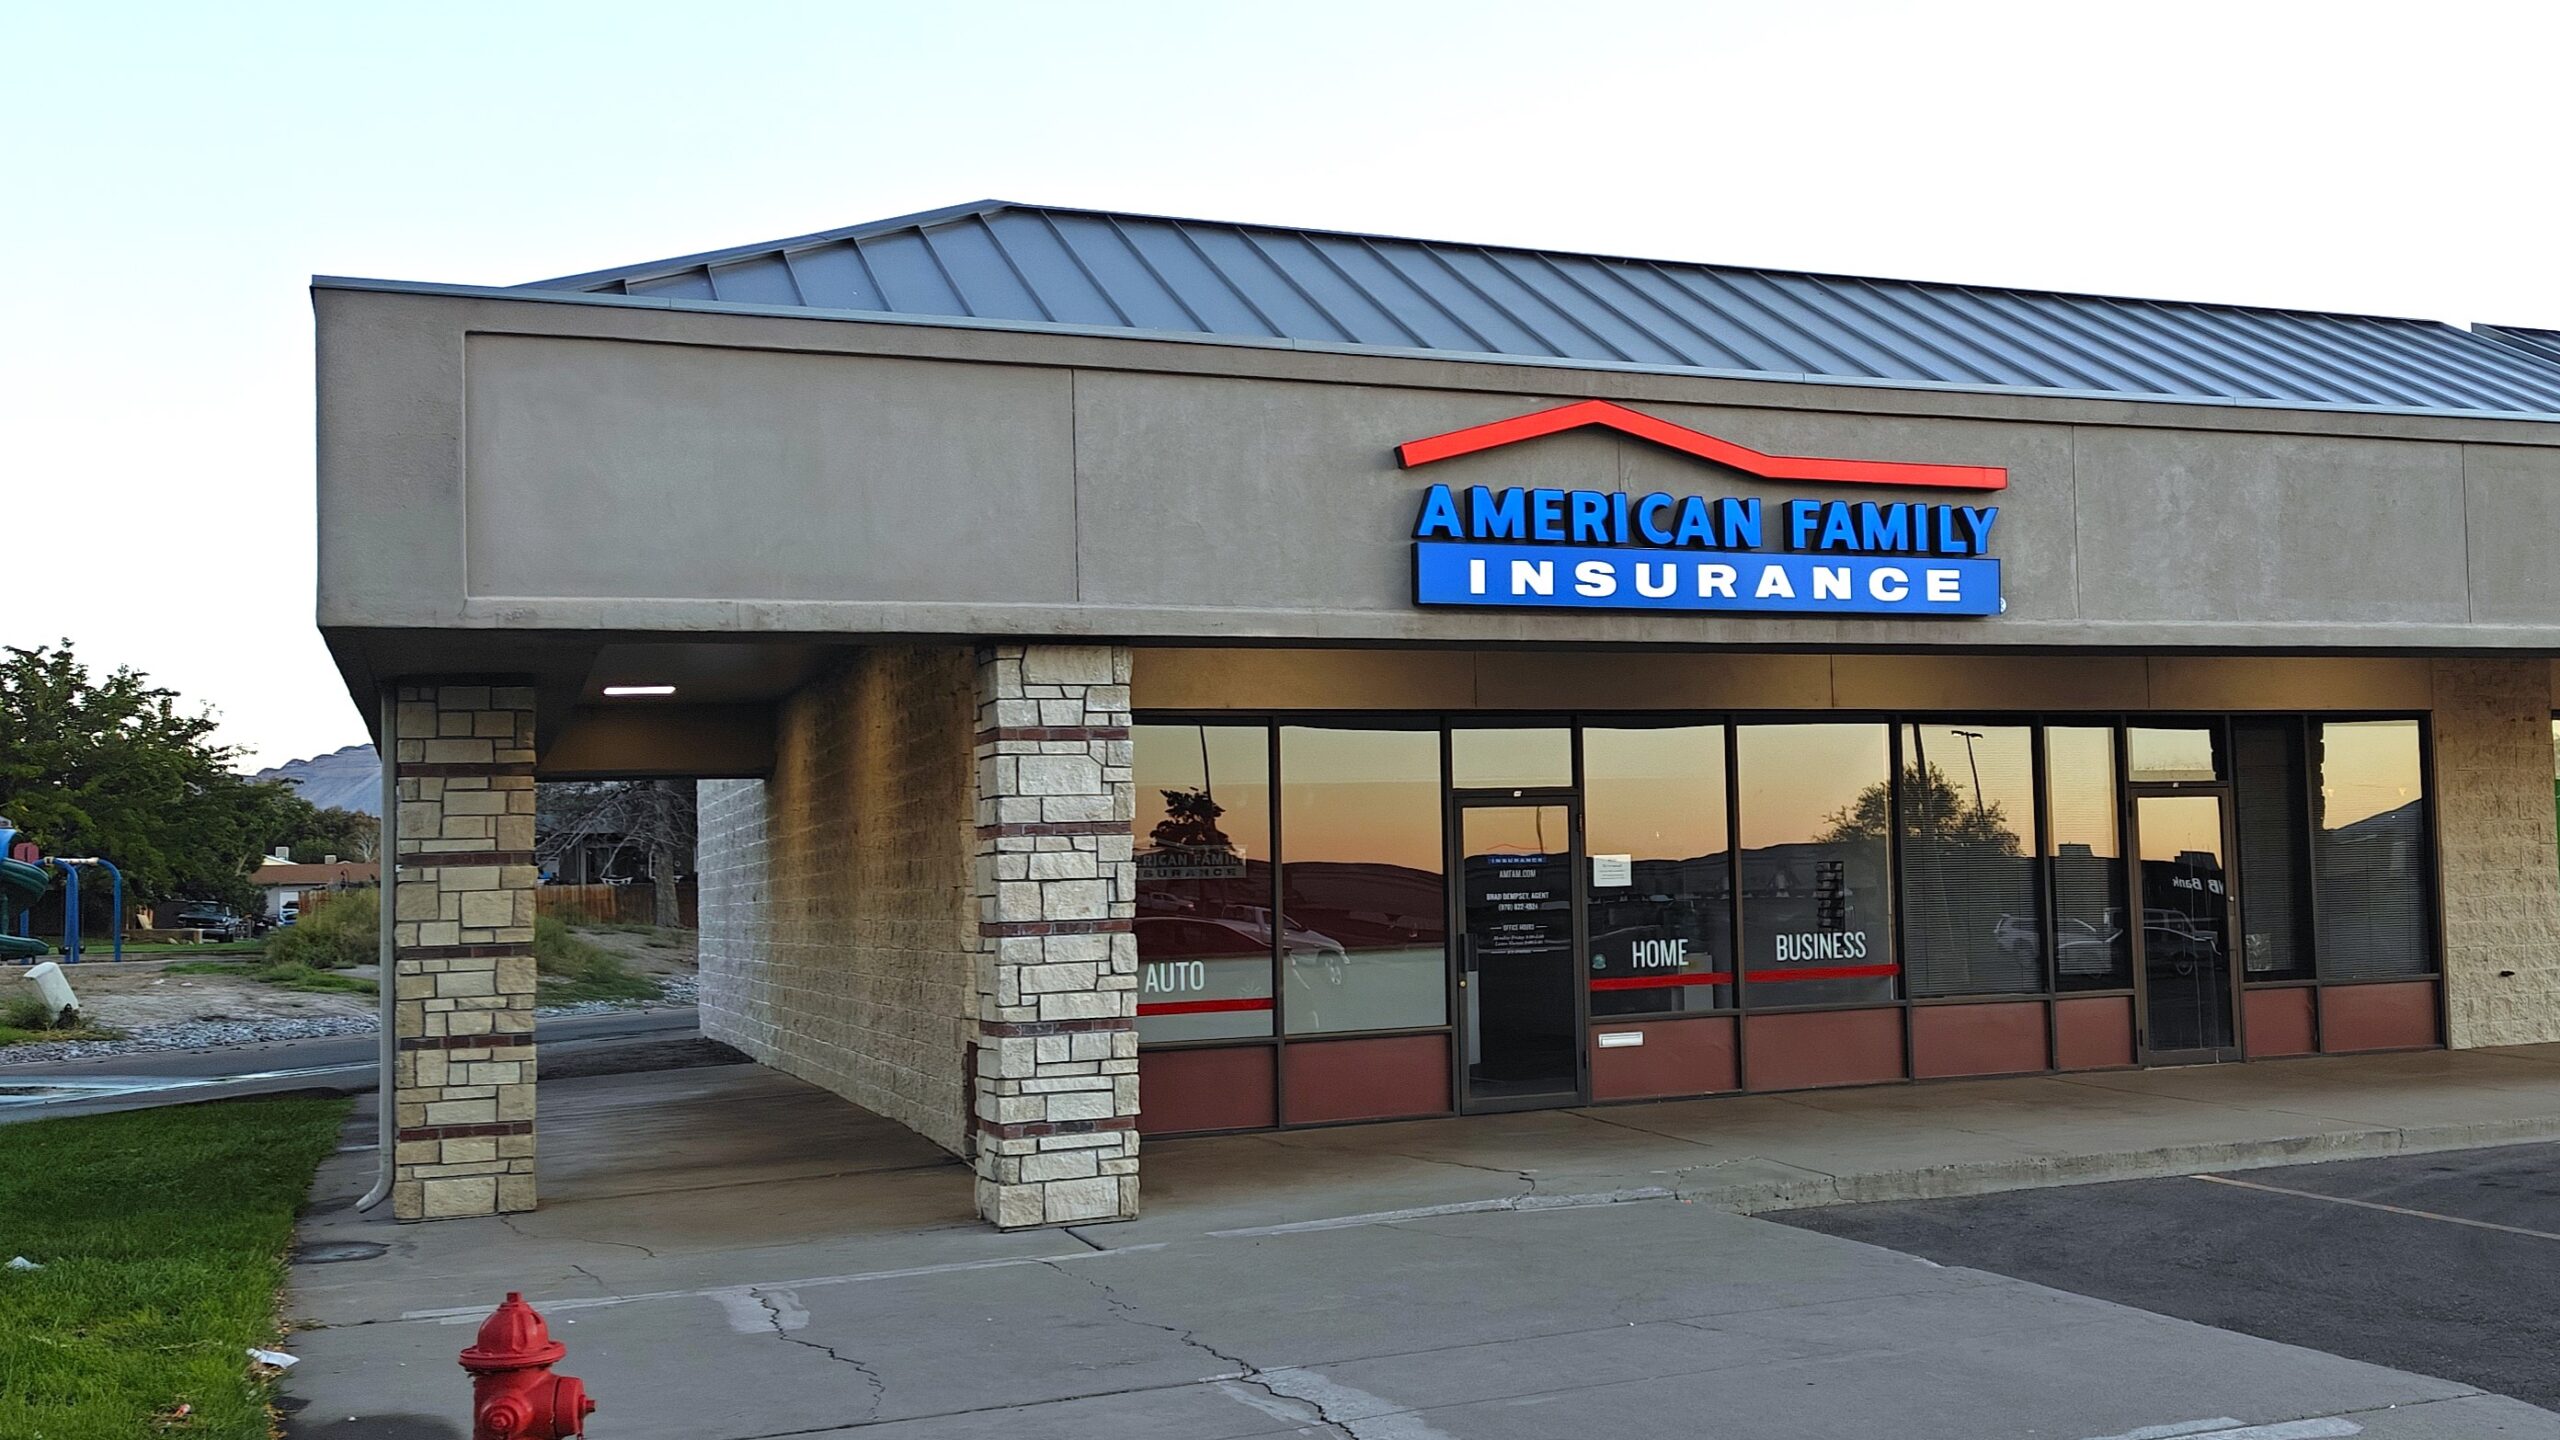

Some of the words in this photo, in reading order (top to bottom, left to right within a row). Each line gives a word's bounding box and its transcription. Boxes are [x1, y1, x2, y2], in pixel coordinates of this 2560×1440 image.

[1412, 484, 1763, 549] AMERICAN
[1783, 499, 1999, 556] FAMILY
[1470, 559, 1962, 602] INSURANCE
[1142, 867, 1237, 878] SURANCE
[1531, 891, 1549, 899] AGENT
[1632, 938, 1689, 969] HOME
[1776, 931, 1867, 962] BUSINESS
[1144, 960, 1206, 993] AUTO
